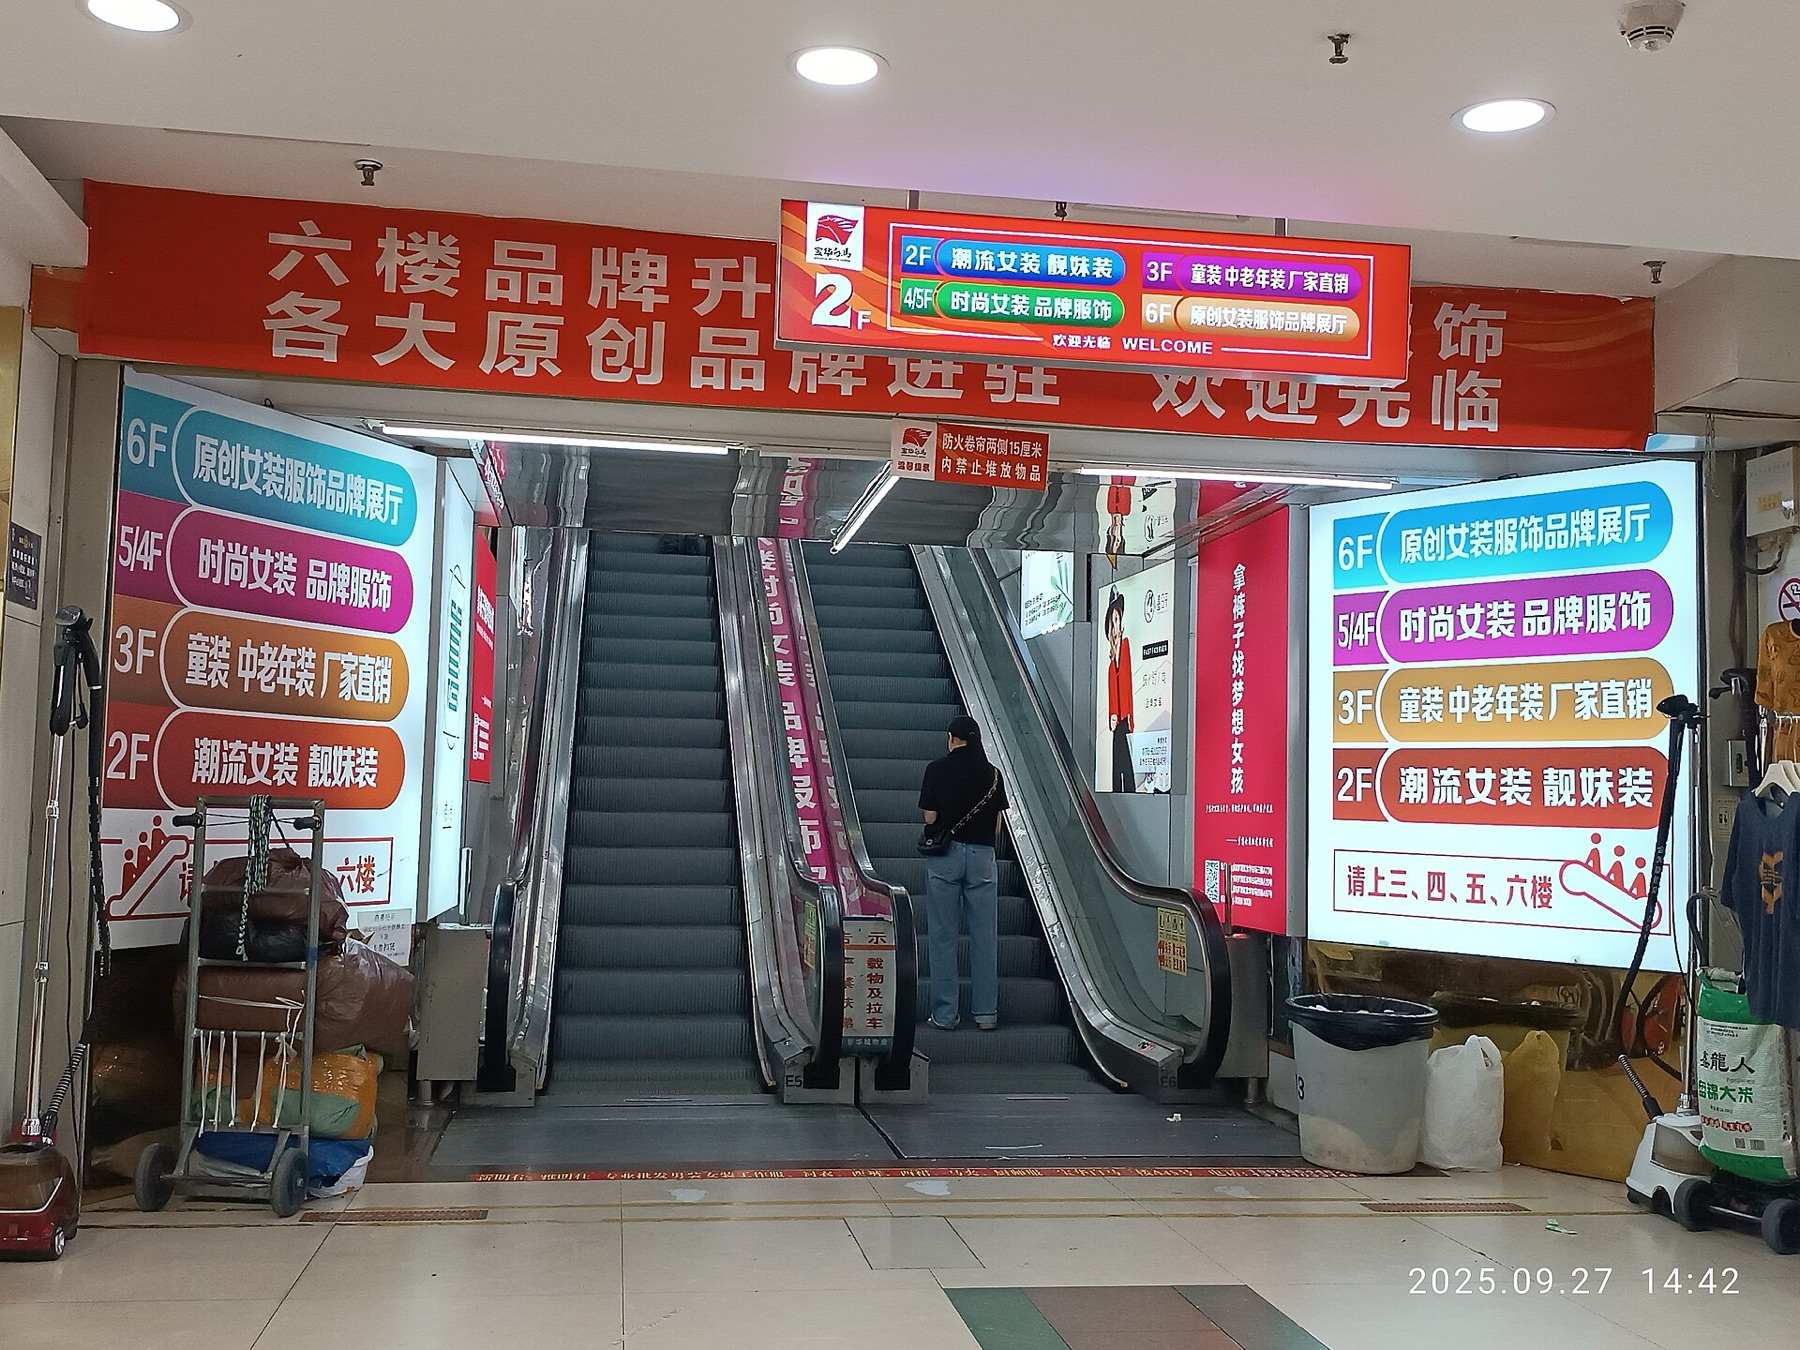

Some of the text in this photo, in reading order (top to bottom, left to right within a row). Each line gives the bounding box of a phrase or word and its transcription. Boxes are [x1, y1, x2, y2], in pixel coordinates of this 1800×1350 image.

[267, 220, 771, 318] 六楼品牌升
[905, 245, 1113, 279] 2F 潮流女装 靓妹装
[1146, 261, 1349, 294] 3F 童装 中老年装 厂家直销
[811, 272, 872, 330] 2F
[904, 287, 1112, 322] 4/5F 时尚女装 品牌服饰
[1145, 302, 1348, 335] 6F 原创女装服饰品牌展厅
[262, 291, 1060, 405] 各大原创品牌进驻
[1053, 334, 1213, 355] 欢迎光临 WELCOME
[942, 456, 1041, 482] 内禁止堆放物品
[943, 433, 1043, 459] 防火卷帘两侧15厘米
[127, 418, 168, 468] 6F
[193, 434, 403, 526] 原创女装服饰品牌展厅
[1338, 503, 1651, 572] 6F 原创女装服饰品牌展厅
[118, 526, 392, 612] 5/4F 时尚女装 品牌服饰
[1337, 591, 1651, 650] 5/4F 时尚女装 品牌服饰
[114, 625, 157, 675] 3F
[185, 632, 231, 689] 童装
[238, 639, 317, 698] 中老年装
[321, 651, 393, 704] 厂家直销
[1338, 678, 1653, 724] 3F 童装 中老年装 厂家直销
[106, 731, 379, 788] 2F 潮流女装 靓妹装
[1337, 767, 1653, 808] 2F 潮流女装 靓妹装
[1347, 865, 1553, 909] 请上三、四、五、六楼
[866, 957, 884, 1029] 载物及拉车
[786, 1075, 802, 1087] E5
